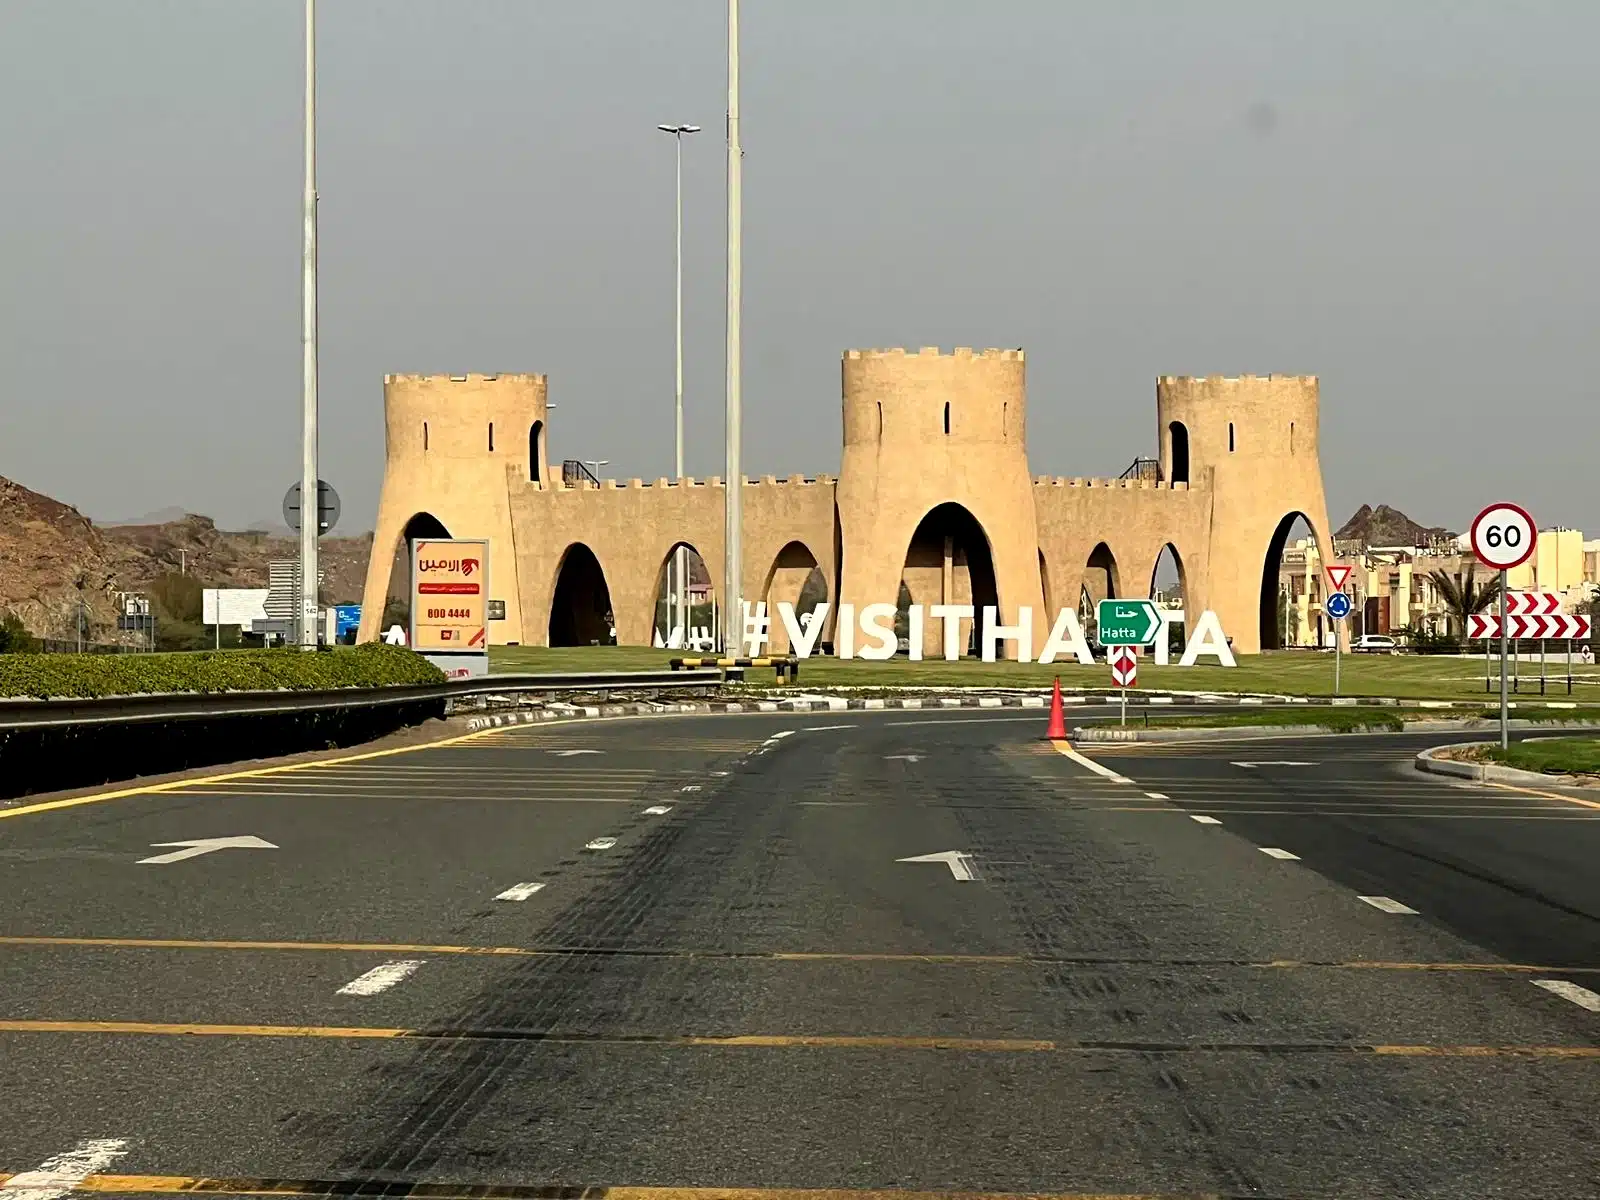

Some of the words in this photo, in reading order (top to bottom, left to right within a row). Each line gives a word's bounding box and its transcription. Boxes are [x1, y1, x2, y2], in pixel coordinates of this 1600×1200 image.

[1486, 525, 1521, 547] 60
[427, 608, 446, 618] 800
[447, 608, 470, 618] 4444
[1115, 606, 1138, 618] حتا
[743, 600, 1238, 667] #VISITHATA
[1101, 627, 1136, 638] Hatta
